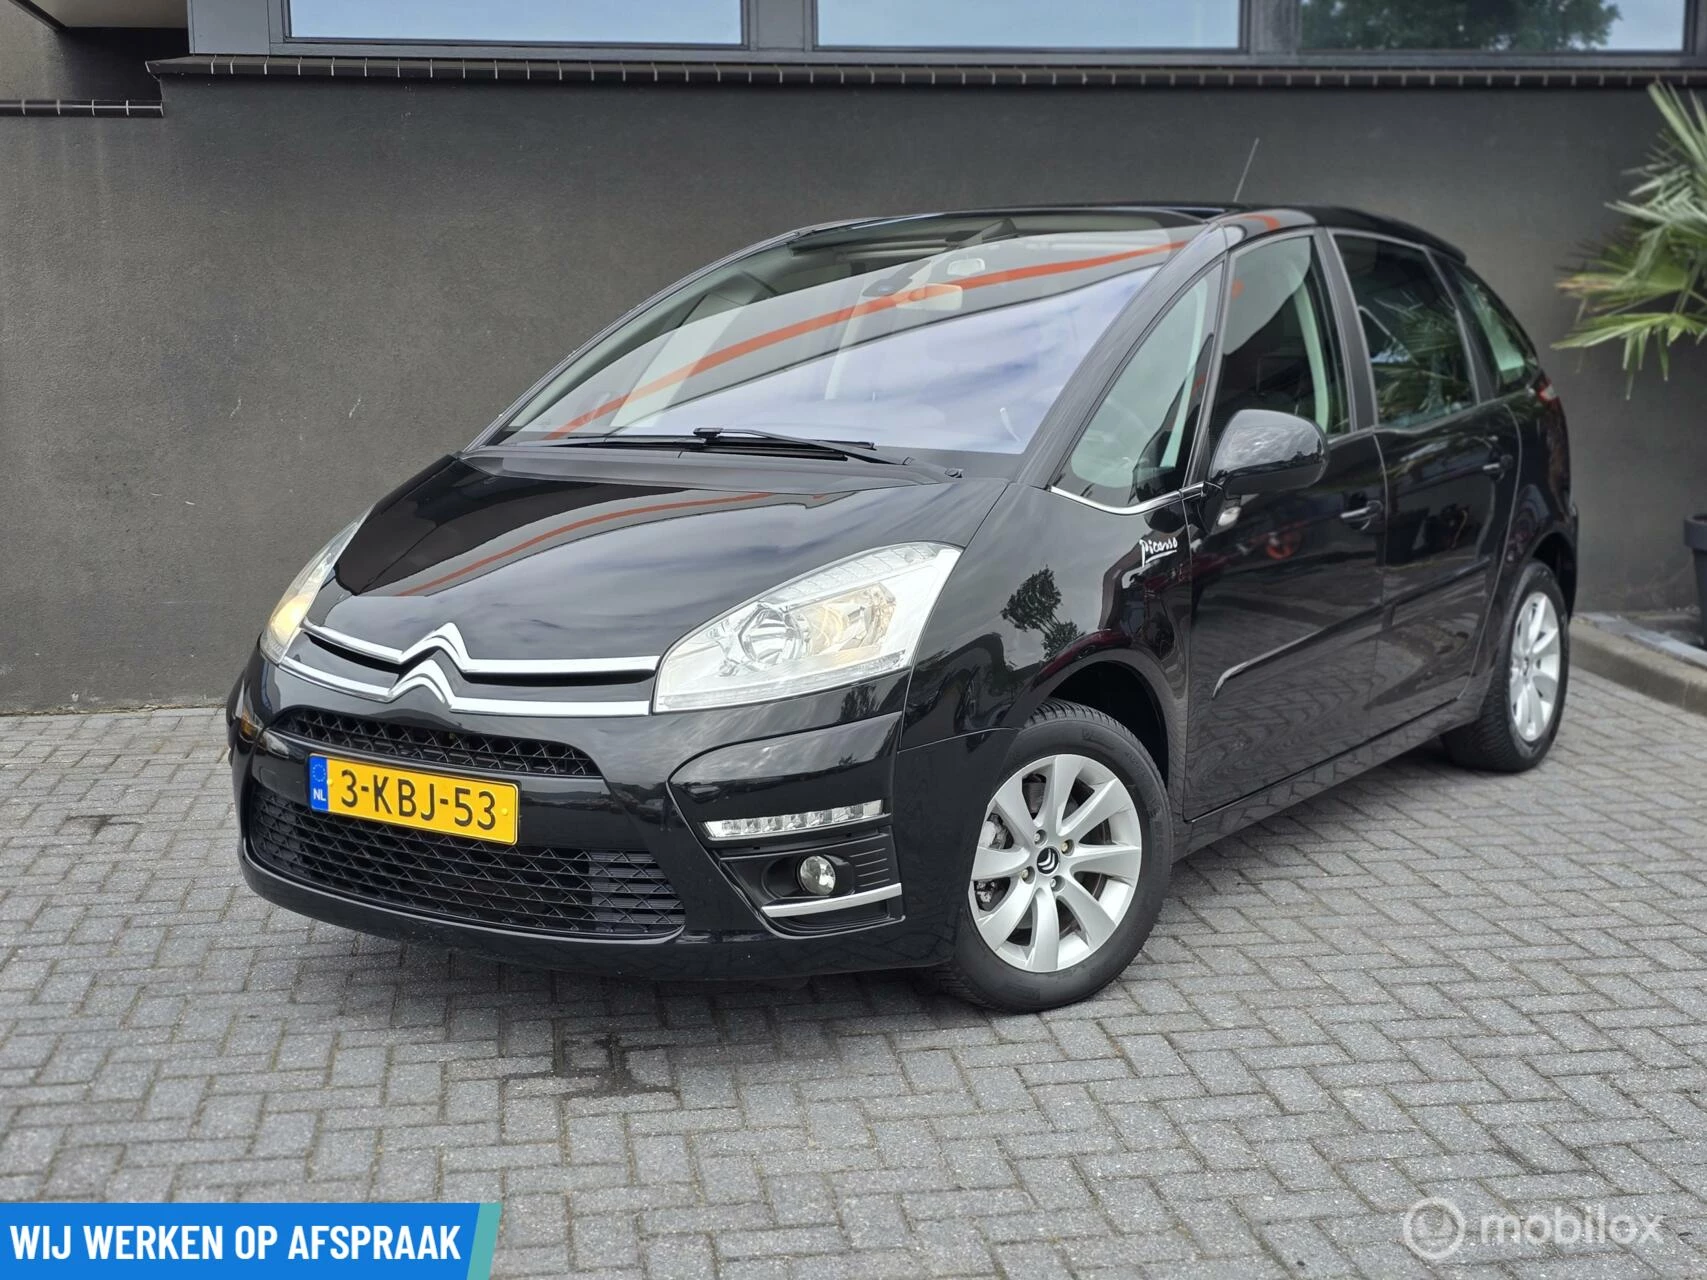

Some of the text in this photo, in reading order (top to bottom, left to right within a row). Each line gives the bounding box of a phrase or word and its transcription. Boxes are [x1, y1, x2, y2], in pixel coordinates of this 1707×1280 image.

[1139, 537, 1178, 568] Picasso
[313, 788, 327, 802] NL
[341, 769, 497, 831] 3-KBJ-53
